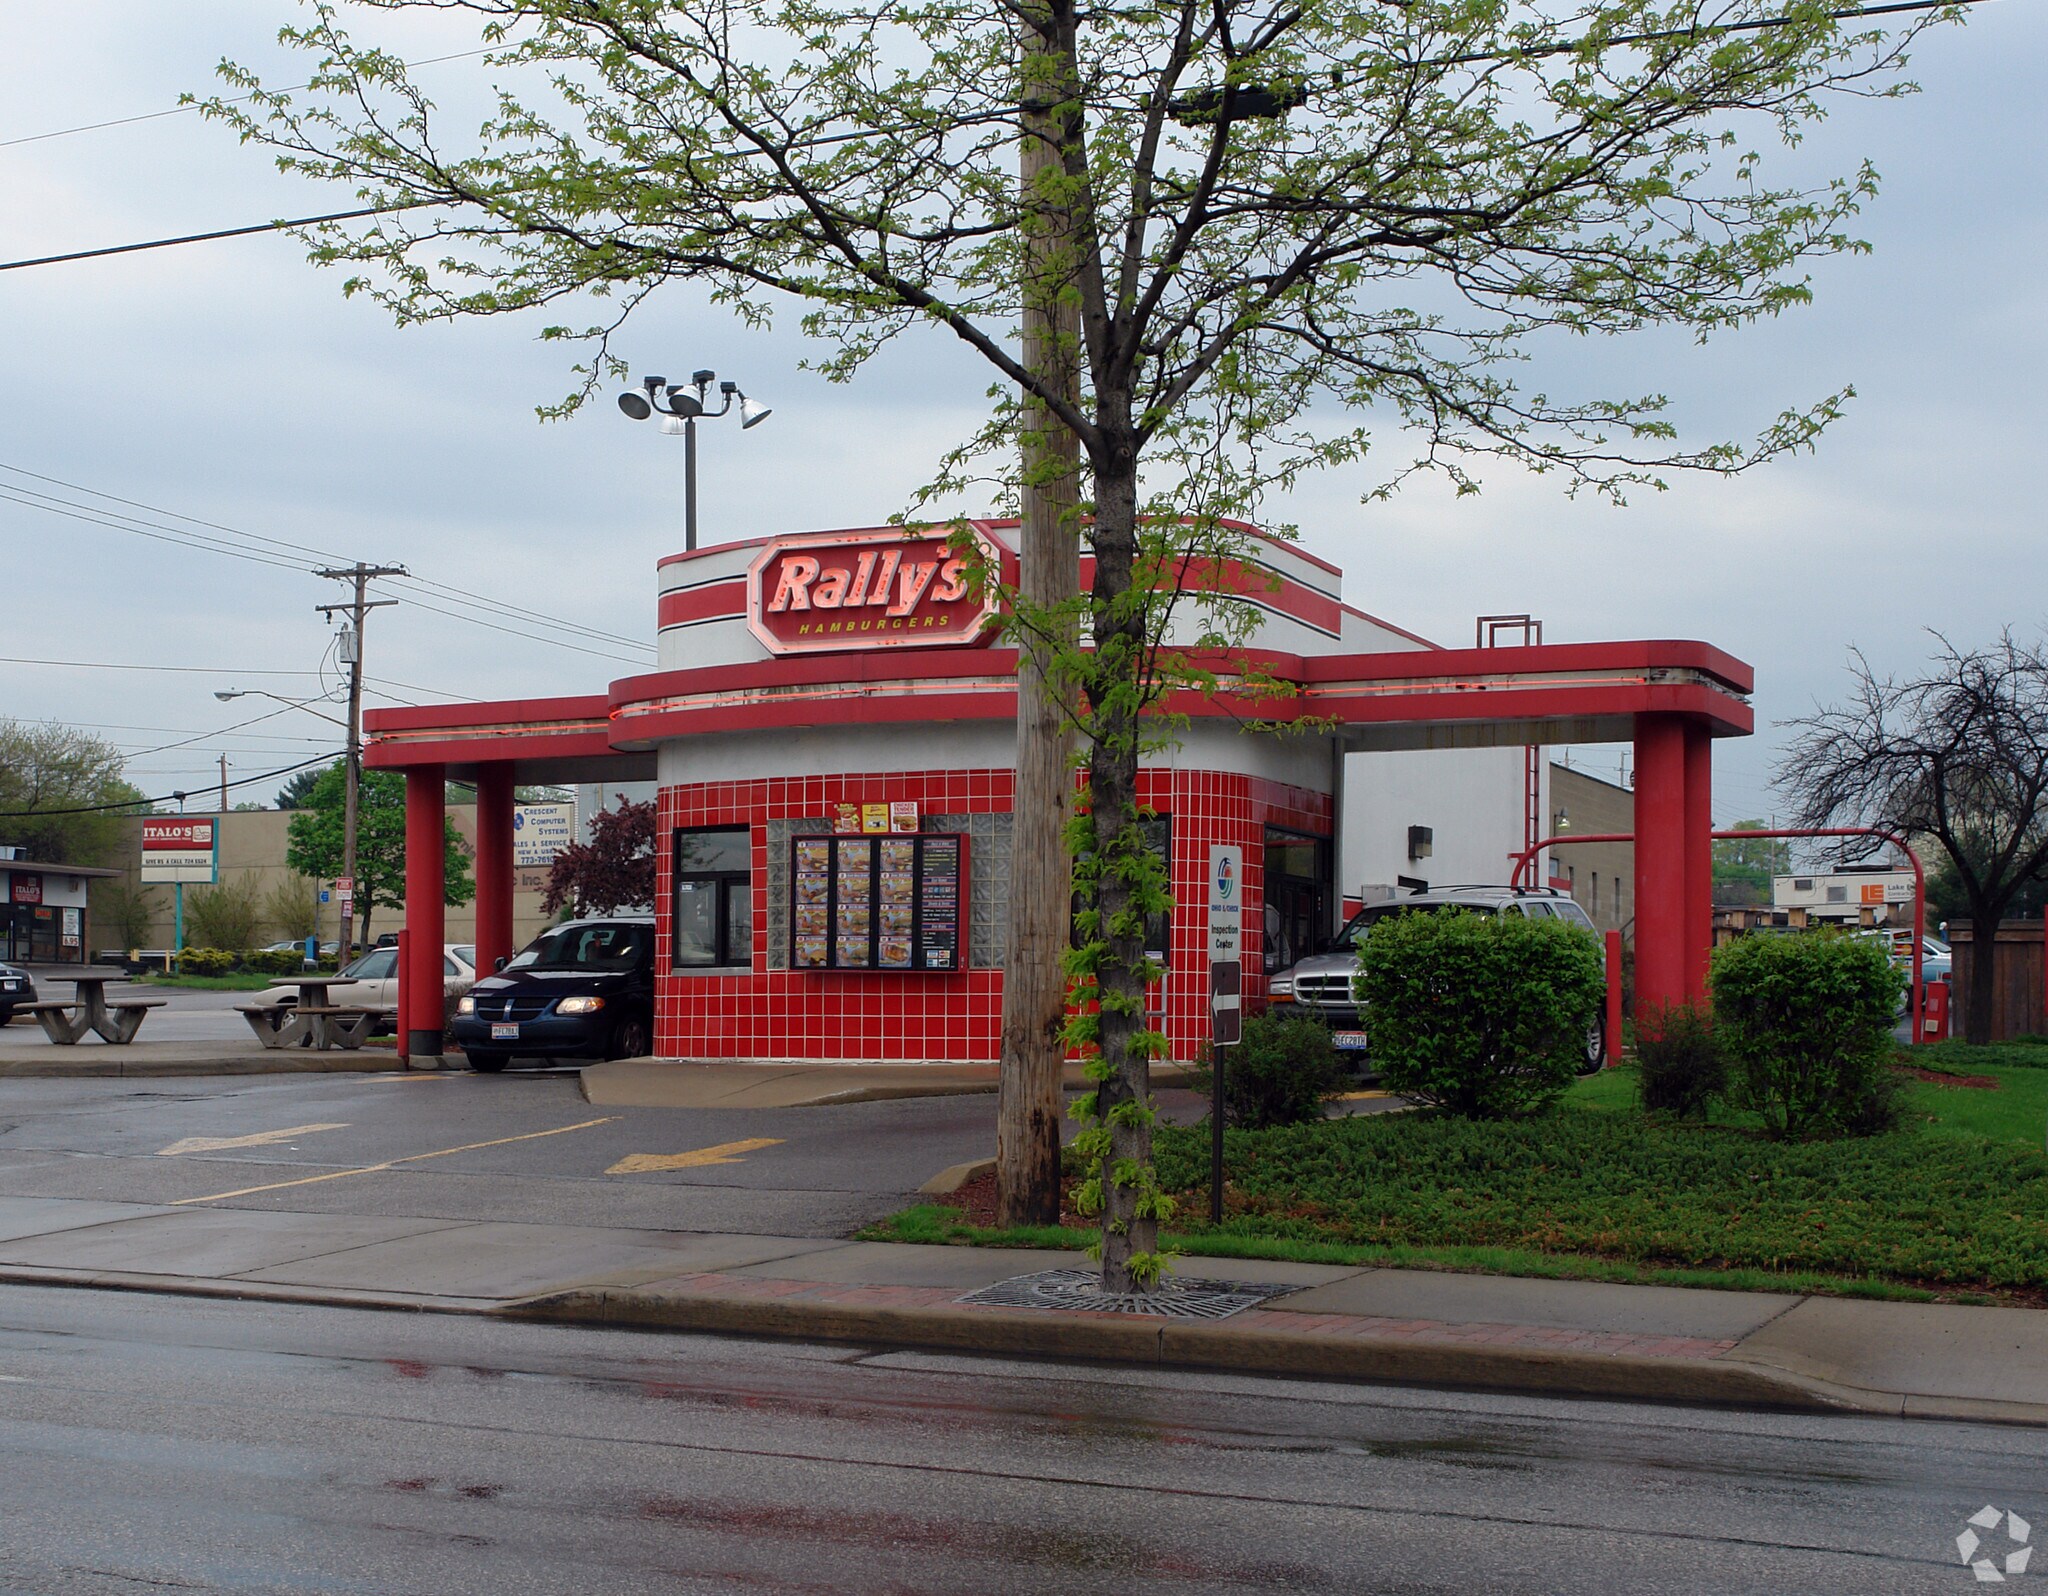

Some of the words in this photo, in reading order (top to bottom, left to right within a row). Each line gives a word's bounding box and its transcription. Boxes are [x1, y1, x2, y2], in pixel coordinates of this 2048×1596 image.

[767, 545, 969, 617] Rally's
[799, 615, 950, 634] HAMBURGERS
[143, 827, 192, 837] ITALO'S
[522, 874, 544, 886] Inc.
[15, 885, 40, 895] ITALO'S
[1211, 923, 1238, 936] Inspection
[1215, 938, 1233, 949] Center
